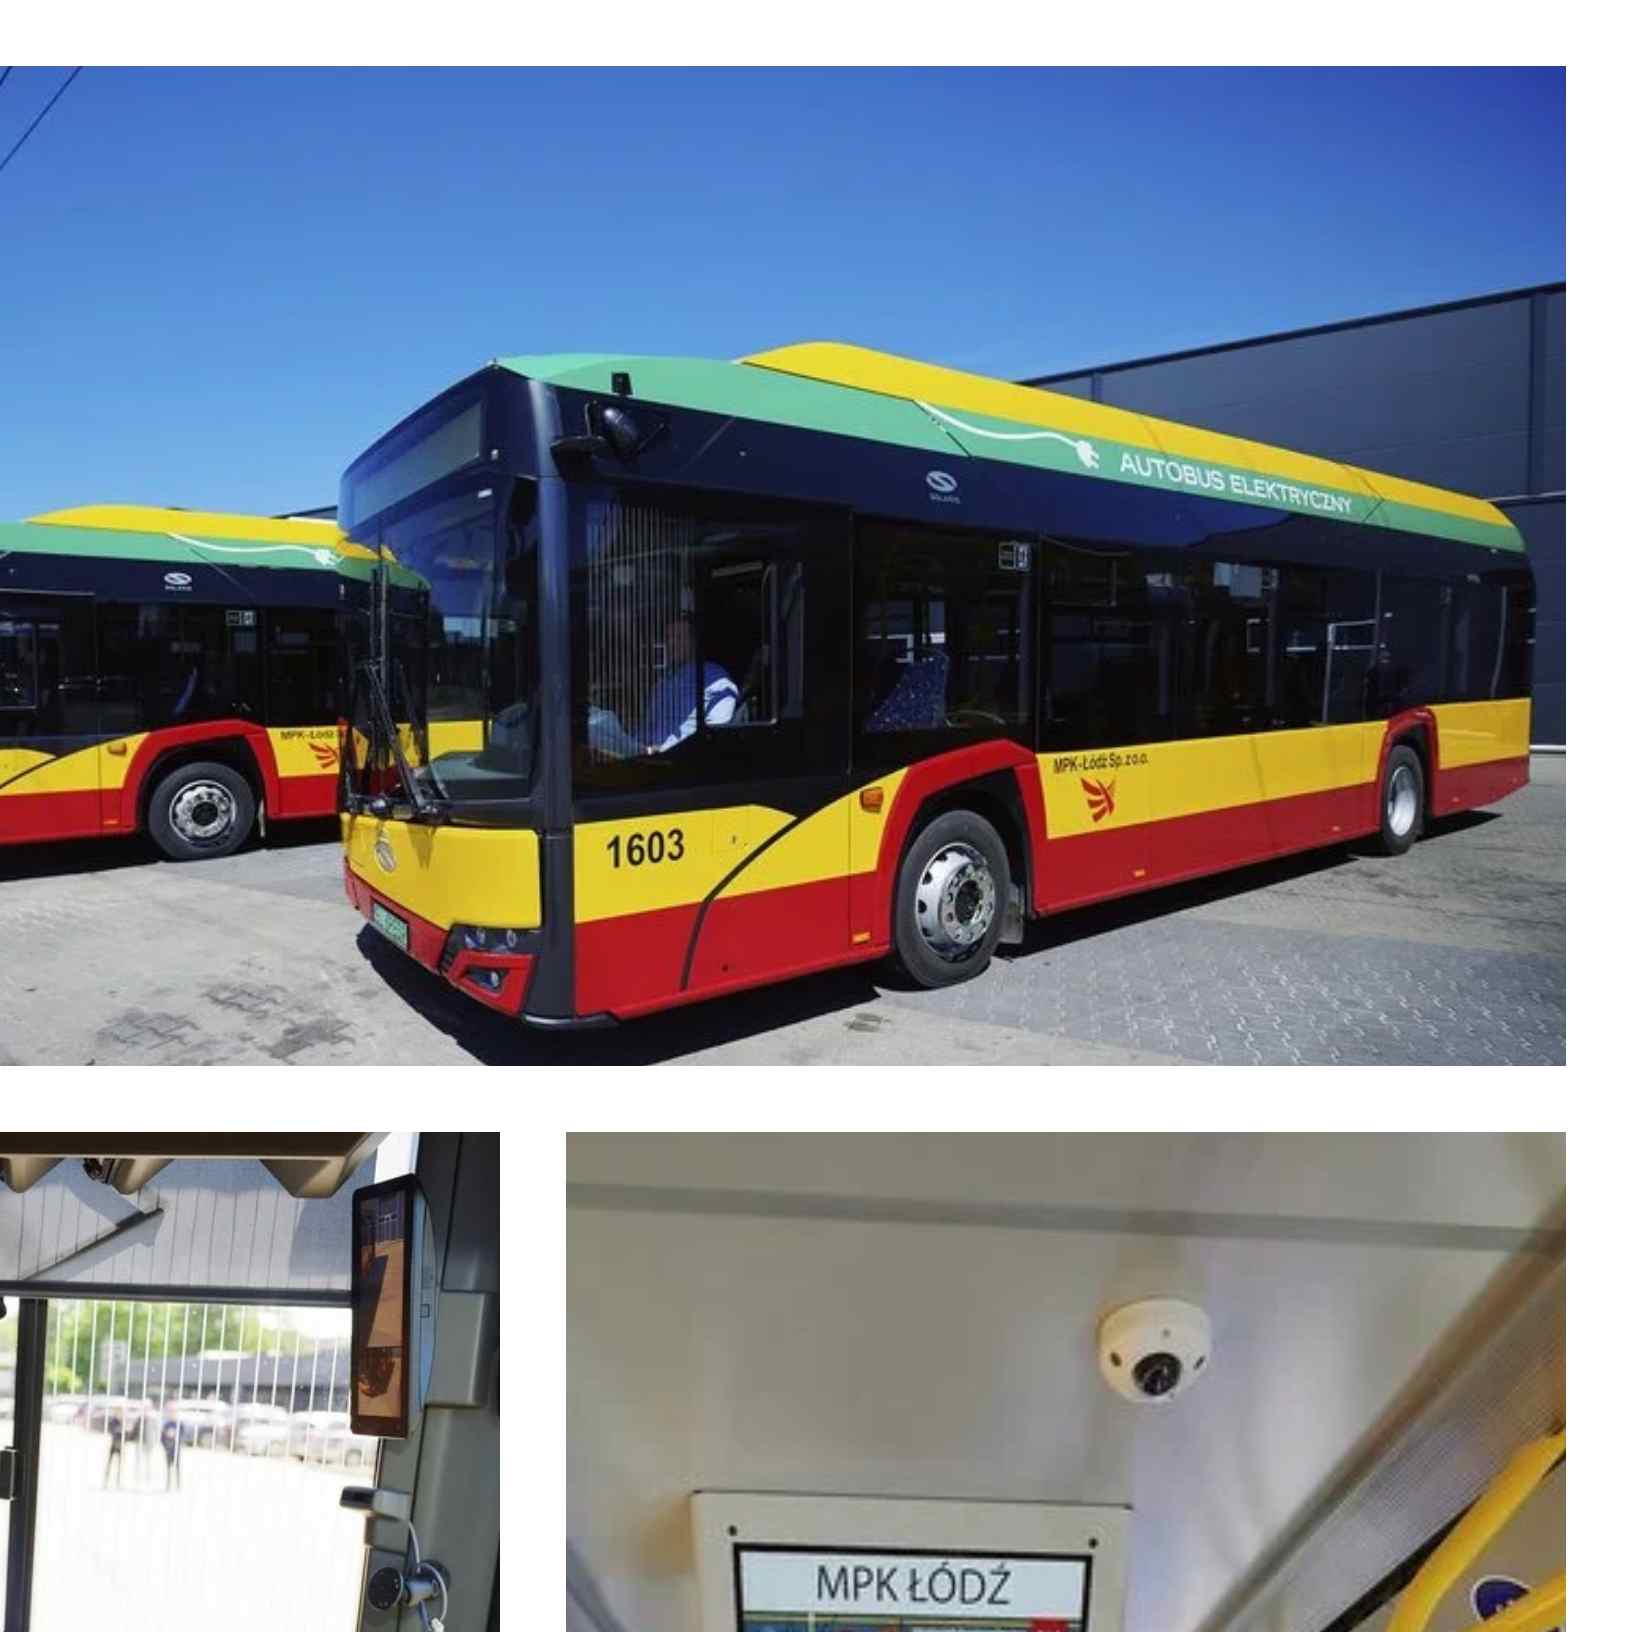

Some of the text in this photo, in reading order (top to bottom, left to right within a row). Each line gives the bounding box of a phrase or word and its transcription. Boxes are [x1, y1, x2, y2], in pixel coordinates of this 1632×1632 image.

[1120, 452, 1352, 513] AUTOBUS ELEKTRYCZNY
[607, 828, 685, 869] 1603
[817, 1561, 1012, 1605] MPK ŁÓDŹ
